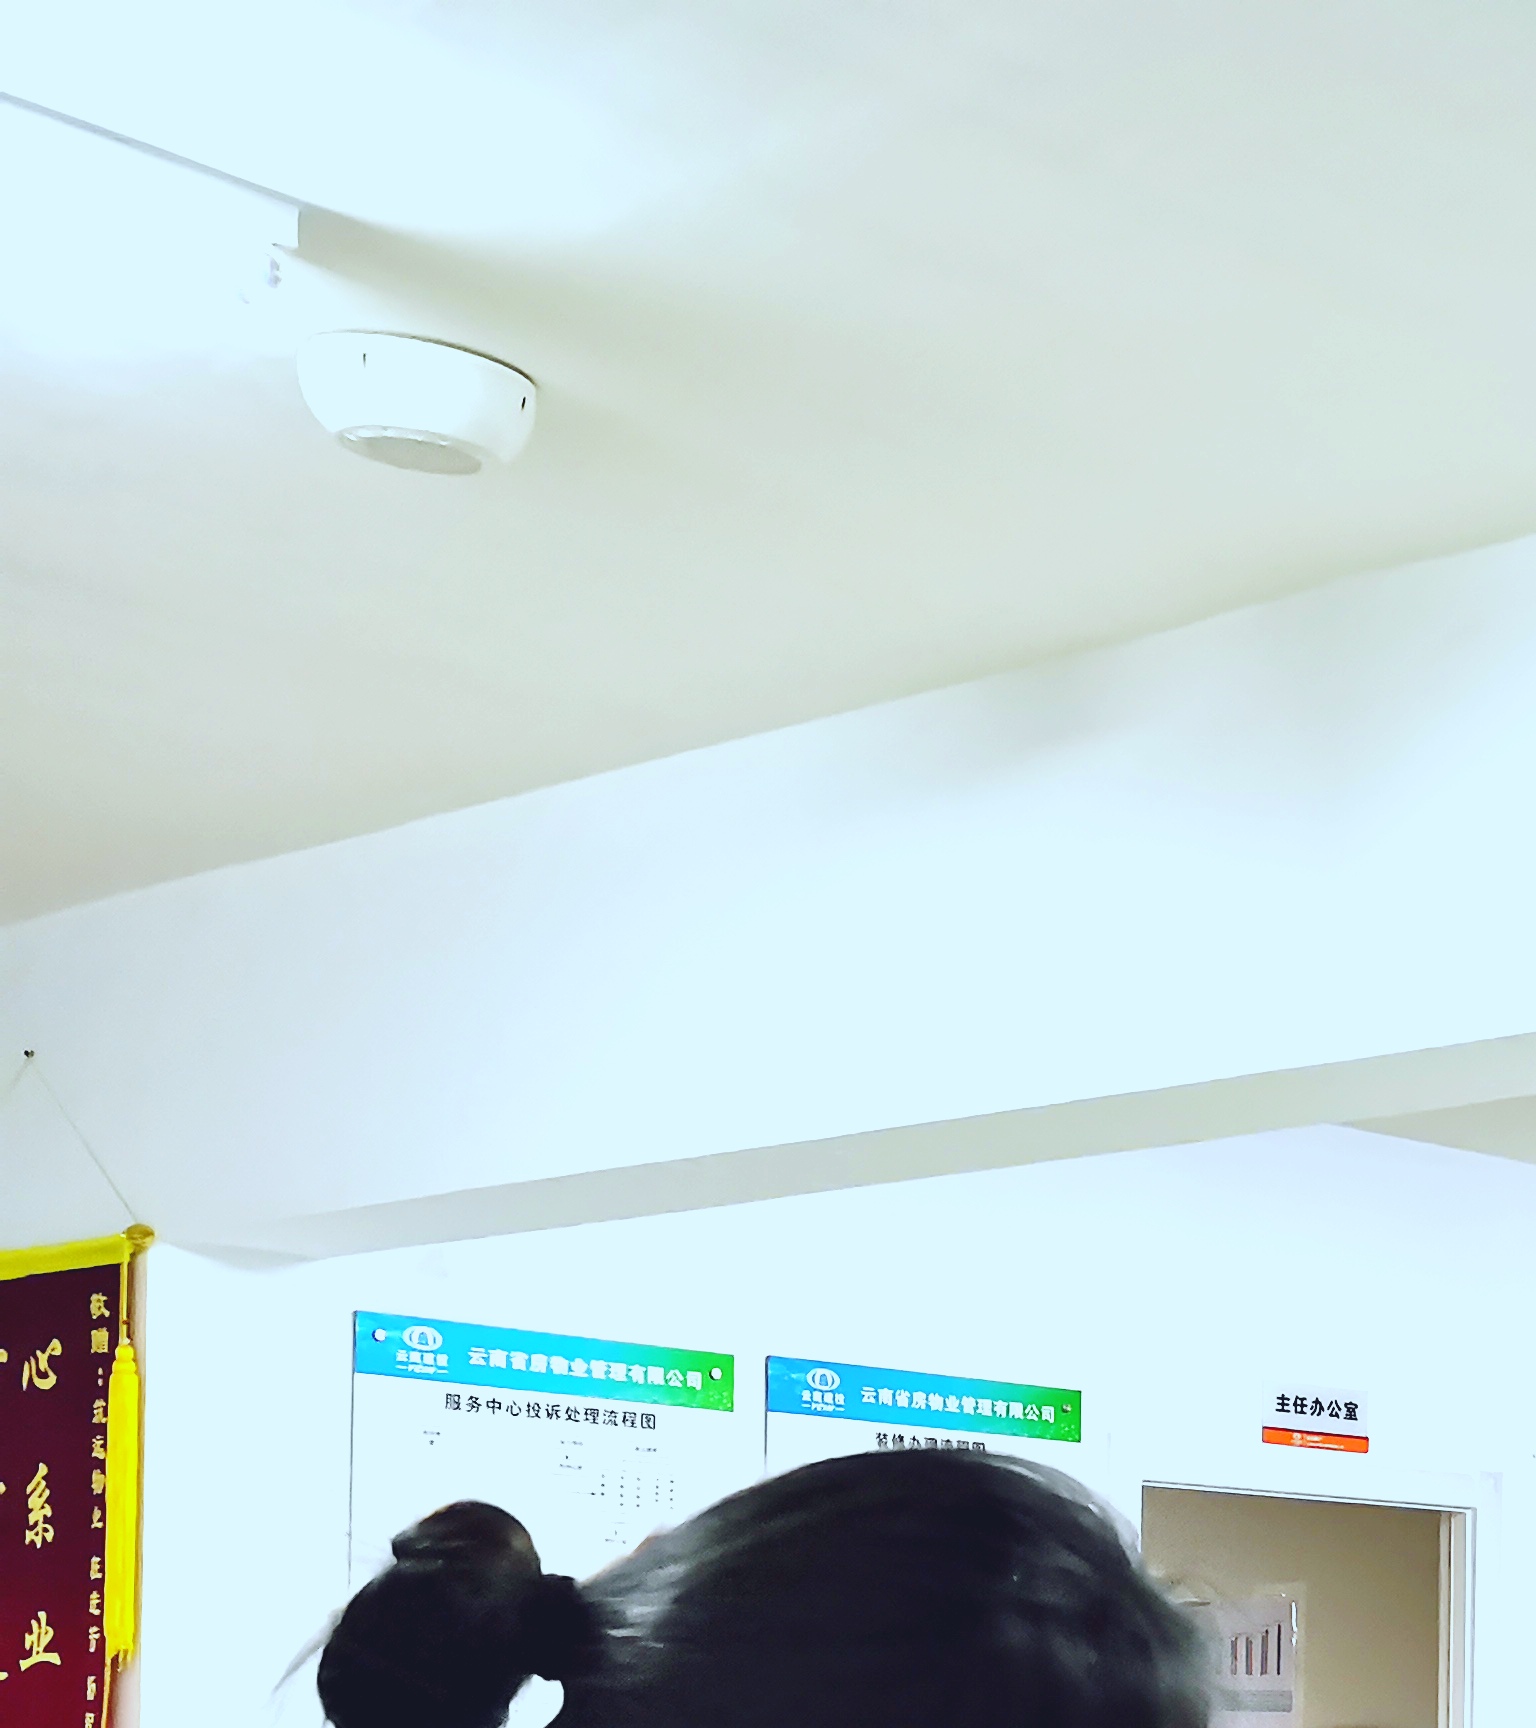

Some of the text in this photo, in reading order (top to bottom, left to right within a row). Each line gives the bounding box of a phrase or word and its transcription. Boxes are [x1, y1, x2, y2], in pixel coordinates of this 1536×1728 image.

[445, 1392, 657, 1430] 服务中心投诉处理流程图
[859, 1386, 1056, 1423] 云南省房物业管理有限公司
[1275, 1393, 1359, 1421] 主任办公室
